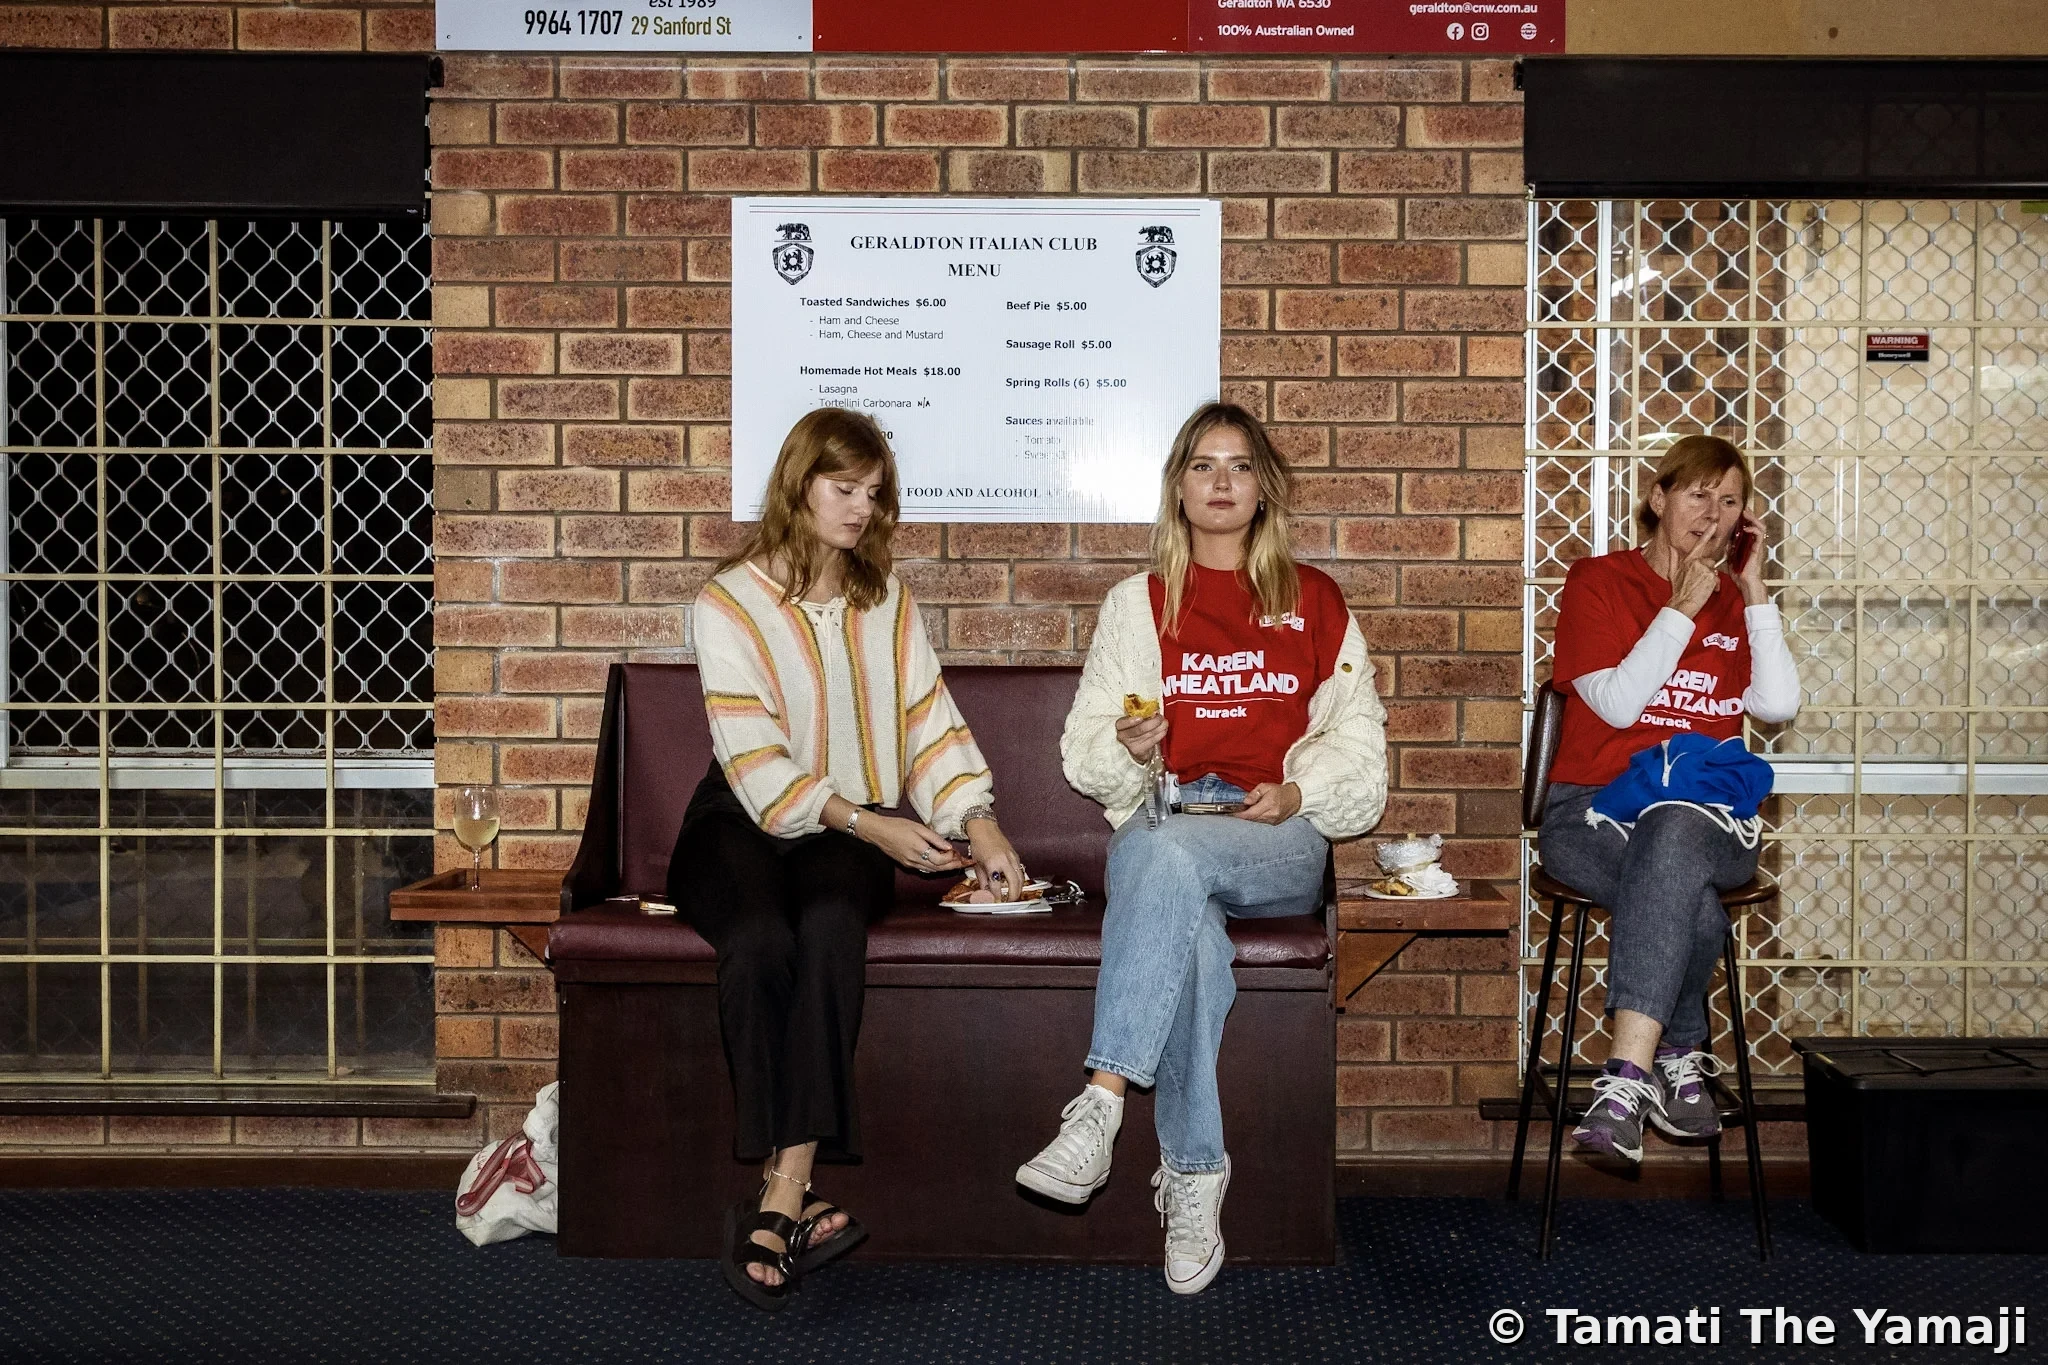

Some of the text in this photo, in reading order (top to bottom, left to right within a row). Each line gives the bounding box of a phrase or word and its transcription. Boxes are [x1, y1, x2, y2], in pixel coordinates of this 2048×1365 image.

[1217, 0, 1331, 8] Geraldton WA 6530
[1410, 2, 1537, 15] geraldton@cnw.com.au
[525, 10, 731, 35] 9964 1707 29 Sanford St
[1218, 25, 1354, 37] 100% Australian Owned
[851, 236, 1097, 251] GERALDTON ITALIAN CLUB
[949, 264, 1000, 277] MENU
[800, 298, 946, 308] Toasted Sandwiches $6.00
[1007, 301, 1086, 312] Beef Pie $5.00
[820, 316, 899, 326] Ham and Cheese
[820, 330, 943, 341] Ham, Cheese and Mustard
[1871, 336, 1918, 345] WARNING
[1007, 340, 1111, 351] Sausage Roll $5.00
[801, 366, 960, 377] Homemade Hot Meals $18.00
[1006, 378, 1126, 390] Spring Rolls (6) $5.00
[819, 385, 857, 396] Lasagna
[819, 398, 911, 408] Tortellini Carbonara
[918, 397, 930, 409] N/A
[1006, 417, 1042, 426] Sauces
[908, 488, 942, 497] FOOD
[948, 488, 972, 497] AND
[976, 487, 1040, 498] ALCOHOL
[1181, 650, 1265, 673] KAREN
[1666, 669, 1718, 695] REN
[1196, 706, 1247, 718] Durack
[1640, 713, 1692, 730] Durack
